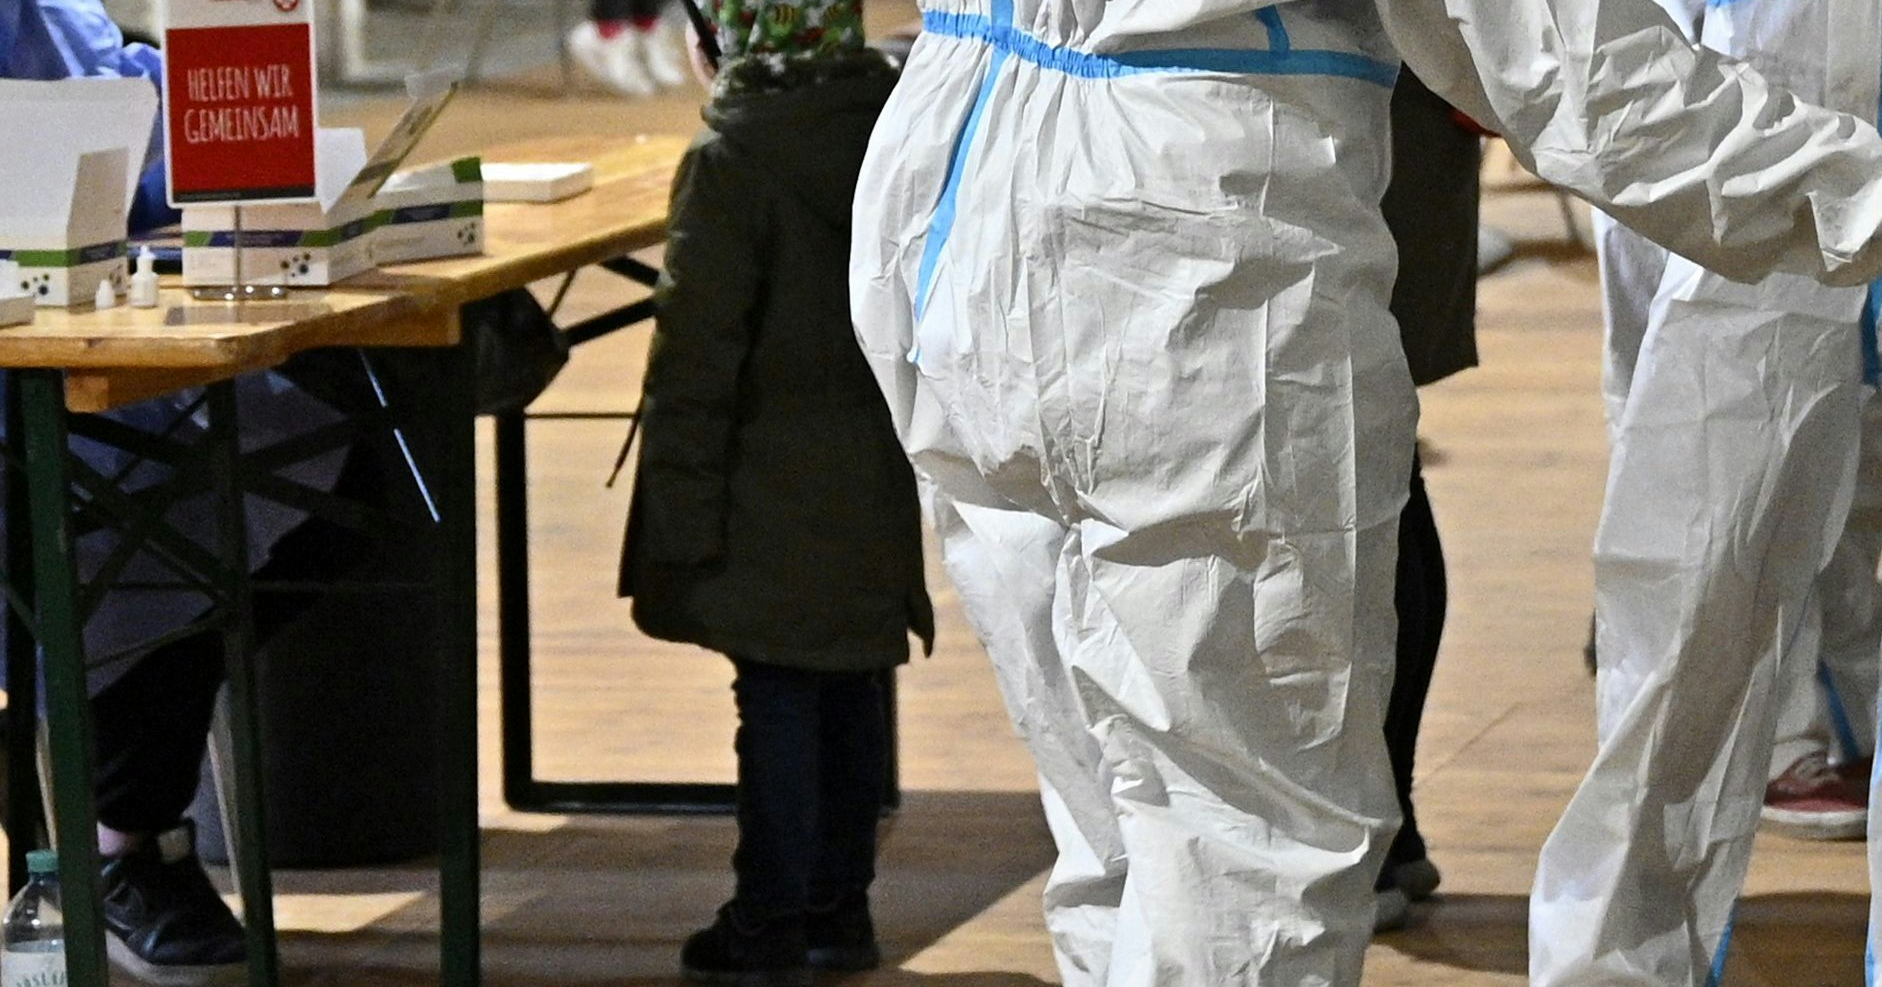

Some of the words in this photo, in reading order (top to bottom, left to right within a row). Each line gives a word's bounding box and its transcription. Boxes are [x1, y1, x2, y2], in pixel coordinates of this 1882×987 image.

[187, 66, 250, 102] HELFEN
[254, 64, 292, 99] WIR
[184, 105, 299, 145] GEMEINSAM
